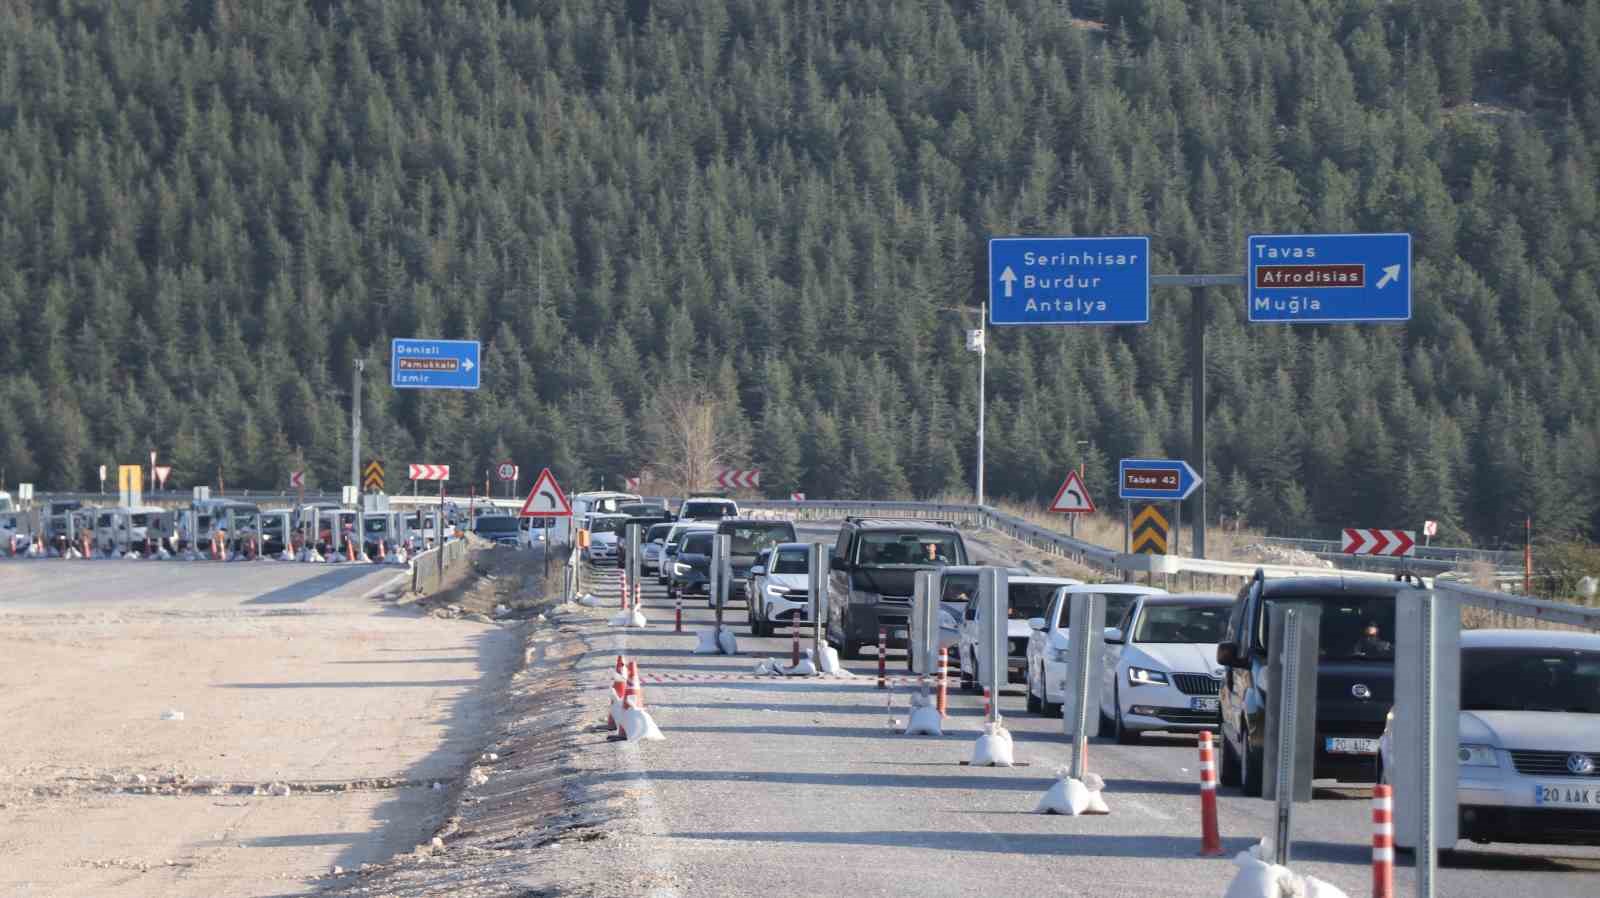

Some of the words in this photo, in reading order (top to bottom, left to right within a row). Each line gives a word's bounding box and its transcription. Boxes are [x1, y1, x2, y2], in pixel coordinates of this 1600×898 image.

[1024, 251, 1138, 265] Serinhisar
[1255, 244, 1316, 258] Tavas
[1024, 274, 1101, 288] Burdur
[1263, 270, 1359, 283] Afrodisias
[1024, 298, 1107, 314] Antalya
[1255, 295, 1321, 313] Muğla
[1161, 475, 1177, 485] 42
[1543, 787, 1560, 802] 20
[1565, 789, 1591, 803] AAK
